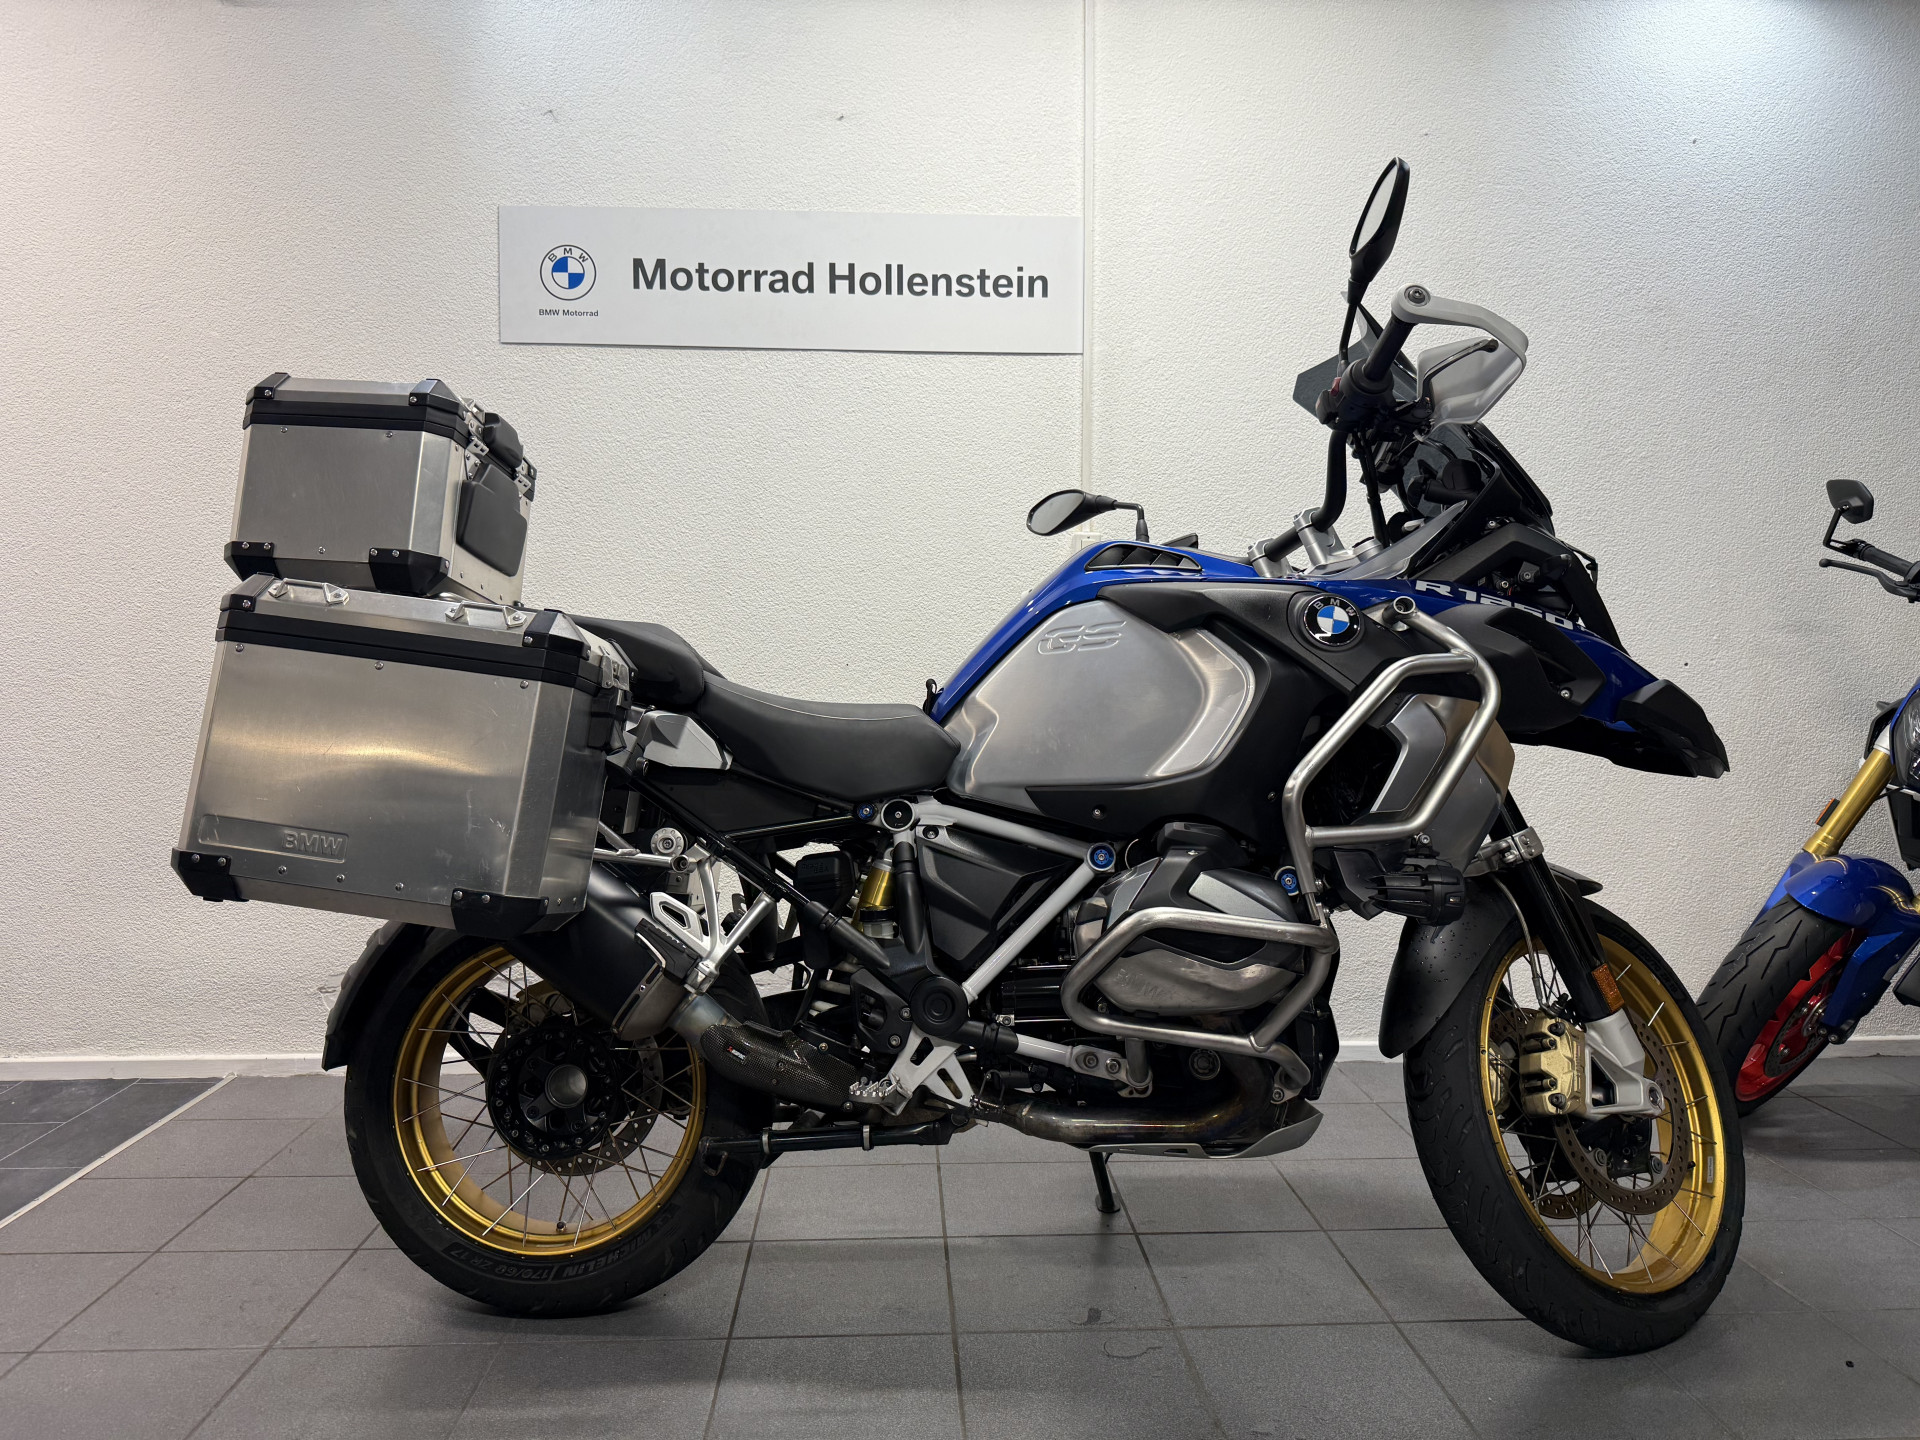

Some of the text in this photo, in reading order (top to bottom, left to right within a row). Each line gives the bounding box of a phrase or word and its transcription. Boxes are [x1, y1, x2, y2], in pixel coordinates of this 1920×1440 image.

[548, 247, 589, 263] BMW
[632, 257, 1049, 299] Motorrad Hollenstein
[538, 308, 599, 317] BMW Motorrad
[1415, 580, 1454, 597] R
[1313, 598, 1356, 616] BMW
[1037, 620, 1127, 655] GS
[282, 829, 343, 856] BMW
[448, 1248, 469, 1259] 17
[560, 1227, 653, 1278] MICHELIN
[494, 1264, 549, 1280] 170/60
